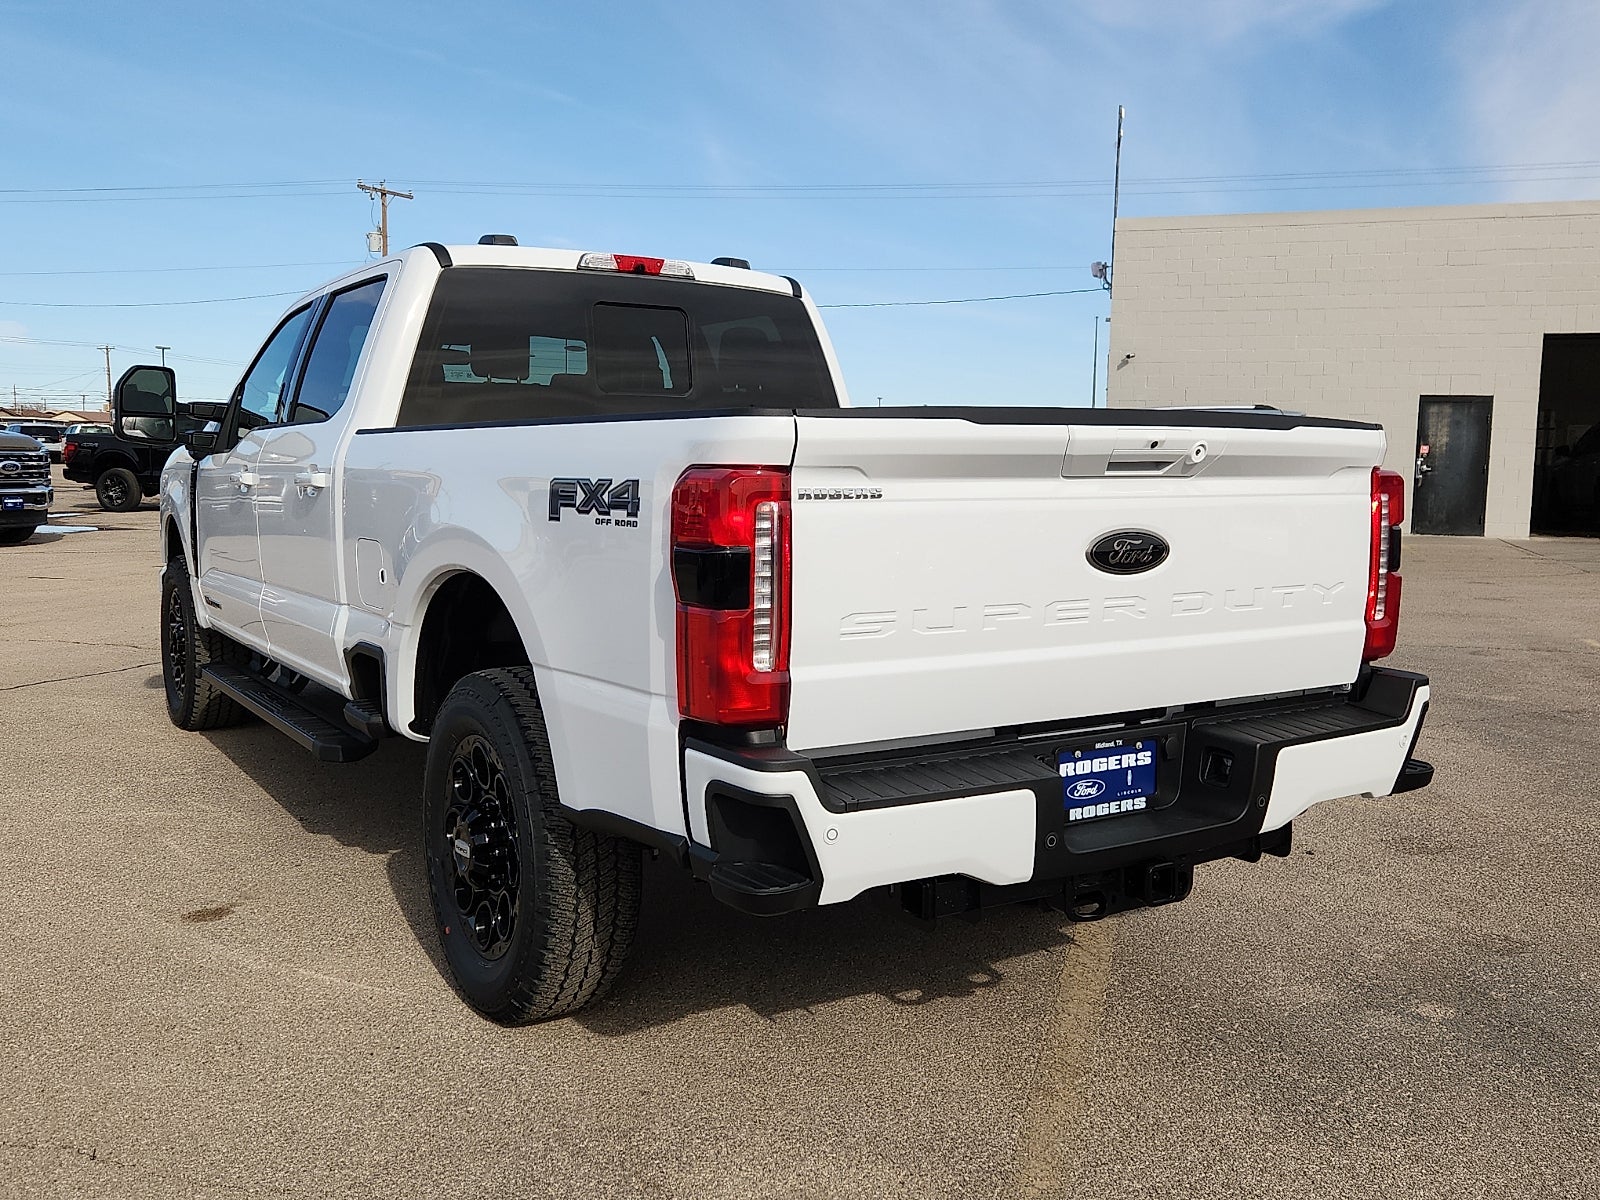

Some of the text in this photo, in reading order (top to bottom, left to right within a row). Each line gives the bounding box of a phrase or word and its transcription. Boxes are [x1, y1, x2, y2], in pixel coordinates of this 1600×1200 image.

[548, 477, 641, 521] FX4
[797, 487, 883, 501] ROGERS
[595, 517, 639, 528] OFF ROAD
[1108, 538, 1154, 565] Ford
[839, 581, 1345, 641] SUPER DUTY
[1095, 741, 1115, 749] Midland,
[1059, 751, 1152, 777] ROGERS
[1073, 781, 1099, 797] Ford
[1069, 796, 1147, 821] ROGERS
